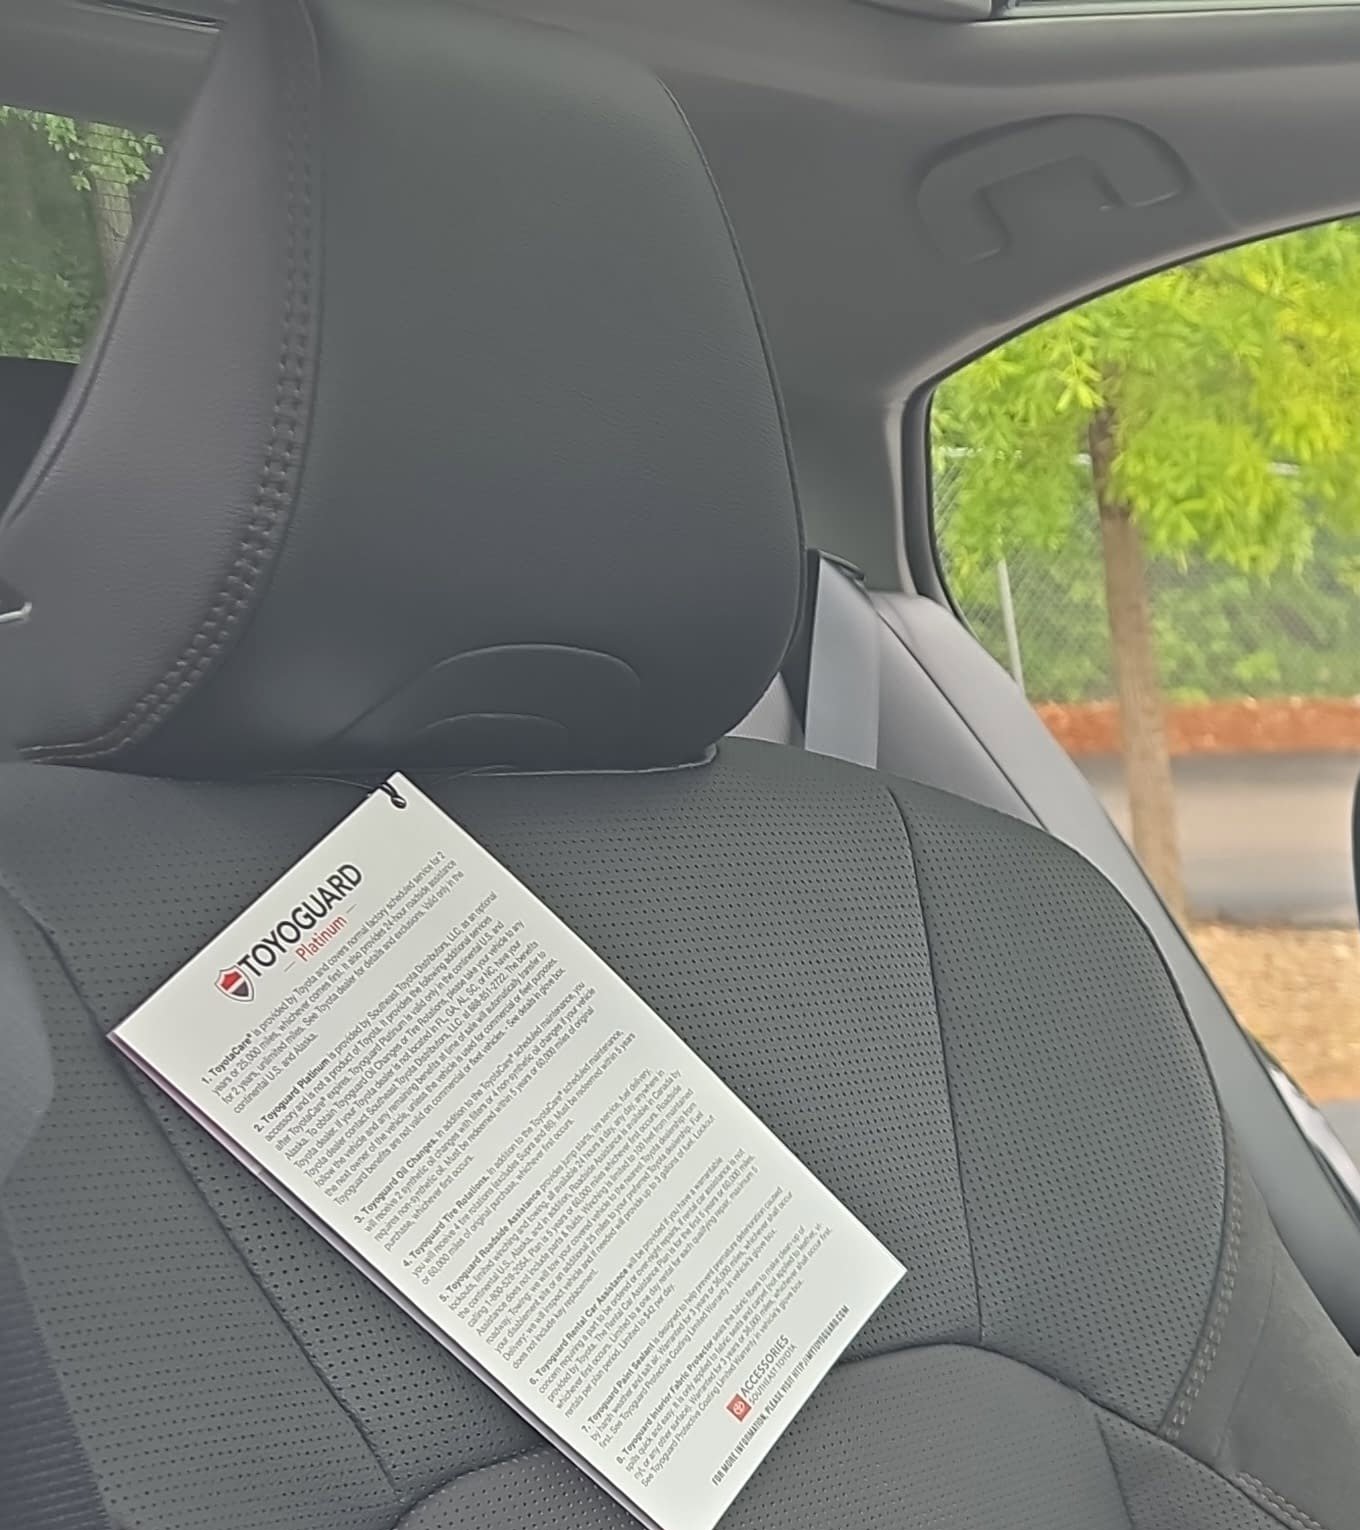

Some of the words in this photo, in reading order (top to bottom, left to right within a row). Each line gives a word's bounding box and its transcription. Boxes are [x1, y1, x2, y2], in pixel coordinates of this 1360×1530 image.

[238, 865, 361, 975] TOYOGUARD
[259, 1001, 289, 1033] provided
[292, 975, 318, 996] Toyota
[327, 945, 350, 966] covers
[347, 924, 370, 948] normal
[364, 908, 390, 928] factory
[386, 880, 416, 910] scheduled
[412, 864, 434, 884] service
[295, 917, 347, 962] Platinum
[211, 1076, 233, 1097] years
[278, 1000, 310, 1032] whichever
[308, 981, 332, 1003] comes
[359, 928, 387, 955] provides
[256, 1040, 288, 1071] unlimited
[314, 993, 339, 1014] Toyota
[336, 974, 356, 995] dealer
[363, 948, 385, 969] details
[260, 1086, 301, 1124] Toyoguard
[296, 1058, 330, 1089] Platinum
[334, 1025, 363, 1056] provided
[367, 989, 400, 1020] Southeast
[395, 971, 419, 992] Toyota
[264, 1109, 299, 1142] accessory
[328, 1052, 355, 1080] product
[385, 996, 413, 1024] provides
[418, 962, 448, 988] following
[469, 916, 493, 939] services
[303, 1156, 329, 1178] Toyota
[326, 1136, 347, 1158] dealer
[344, 1113, 370, 1139] contact
[366, 1083, 399, 1116] Southeast
[514, 941, 539, 964] benefits
[315, 1108, 338, 1130] obtain
[333, 1076, 368, 1109] Toyoguard
[373, 1043, 403, 1070] Changes
[488, 936, 509, 956] vehicle
[348, 1042, 382, 1076] Toyoguard
[378, 1019, 408, 1047] Platinum
[410, 998, 427, 1016] valid
[452, 942, 483, 975] continental
[233, 1077, 269, 1114] continental
[293, 1147, 319, 1169] Toyota
[374, 1068, 395, 1089] dealer
[407, 1029, 433, 1054] located
[313, 1167, 336, 1188] follow
[343, 1135, 368, 1158] vehicle
[388, 1082, 420, 1113] remaining
[414, 1060, 441, 1085] benefits
[485, 977, 522, 1014] automatically
[517, 956, 540, 979] transfer
[333, 1171, 368, 1205] Toyoguard
[364, 1148, 392, 1174] benefits
[431, 1070, 466, 1106] commercial
[517, 997, 537, 1017] details
[349, 1150, 370, 1172] owner
[483, 999, 516, 1034] commercial
[360, 1176, 399, 1215] Toyoguard
[406, 1138, 439, 1168] Changes.
[408, 1220, 446, 1259] Toyoguard
[455, 1176, 490, 1209] Rotations.
[445, 1255, 482, 1293] Toyoguard
[478, 1225, 510, 1258] Roadside
[507, 1189, 542, 1227] Assistance
[535, 1338, 569, 1377] Toyoguard
[565, 1315, 588, 1341] Rental
[596, 1268, 629, 1306] Assistance
[740, 1334, 789, 1398] ACCESSORIES
[748, 1366, 778, 1405] SOUTHEAST
[775, 1343, 798, 1369] TOYOTA
[587, 1386, 619, 1424] Toyoguard
[615, 1368, 635, 1389] Paint
[631, 1342, 656, 1370] Sealant
[621, 1417, 653, 1455] Toyoguard
[649, 1392, 672, 1420] Interior
[669, 1371, 690, 1394] Fabric
[686, 1339, 714, 1373] Protector
[711, 1470, 726, 1486] FOR
[720, 1452, 739, 1474] MORE
[764, 1391, 785, 1415] PLEASE
[780, 1375, 795, 1394] VISIT
